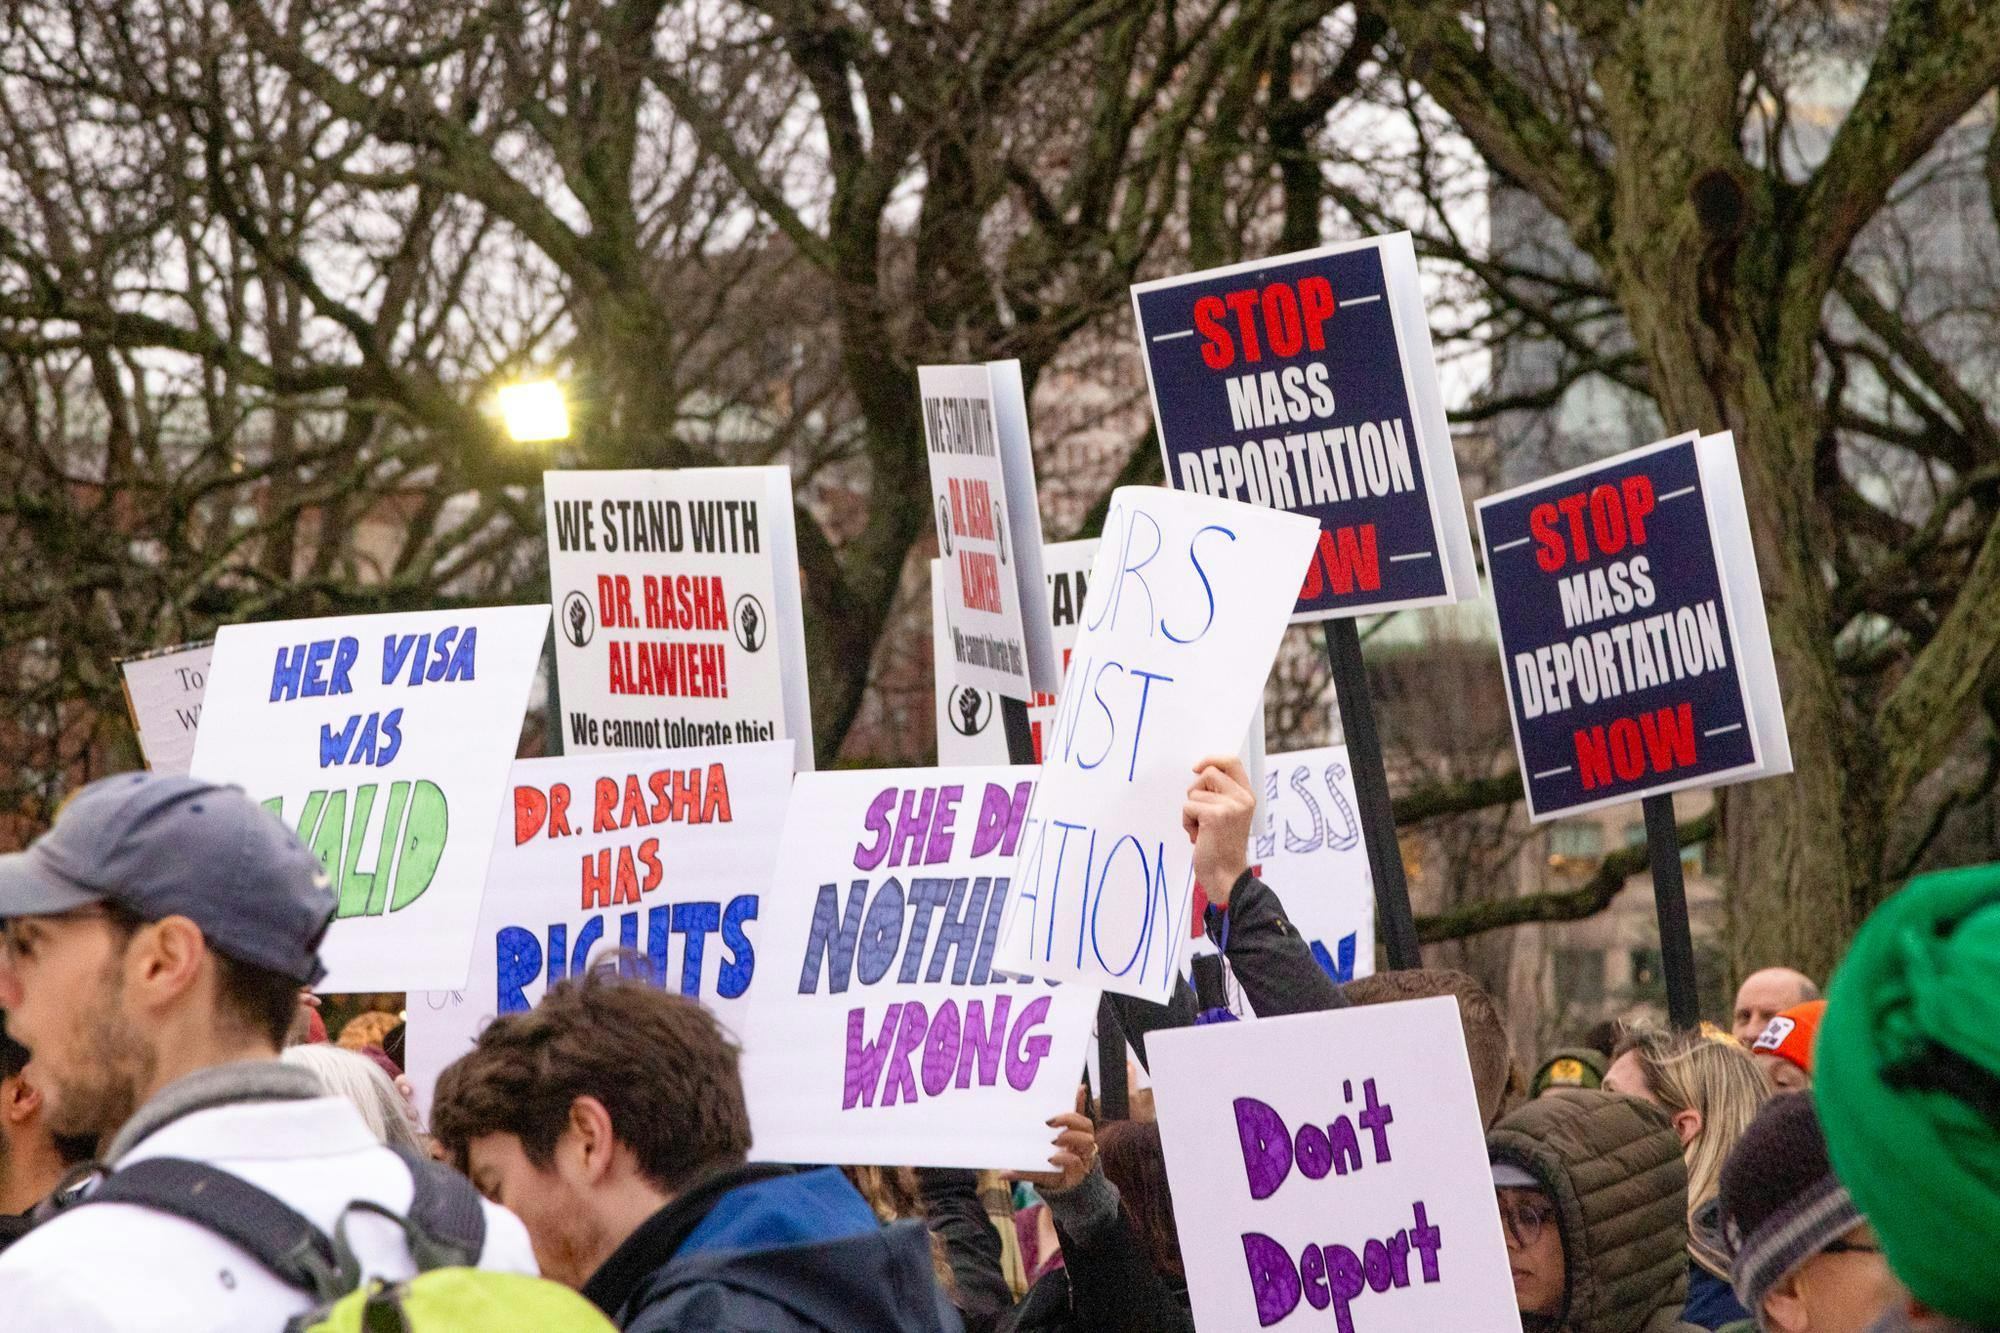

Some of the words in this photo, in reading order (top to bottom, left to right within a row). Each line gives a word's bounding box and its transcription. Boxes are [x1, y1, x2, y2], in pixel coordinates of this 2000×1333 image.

[1194, 276, 1335, 370] STOP
[1225, 361, 1336, 432] MASS
[1178, 418, 1415, 510] DEPORTATION
[554, 500, 596, 552] WE
[601, 499, 683, 553] STAND
[688, 500, 760, 554] WITH
[1529, 475, 1655, 572] STOP
[597, 574, 640, 628] DR.
[643, 574, 729, 631] RASHA
[1558, 555, 1656, 628] MASS
[269, 636, 359, 703] HER
[382, 626, 477, 687] VISA
[608, 641, 728, 699] ALAWIEH!
[1515, 600, 1727, 720] DEPORTATION
[320, 708, 403, 768] WAS
[570, 712, 598, 746] We
[602, 718, 661, 749] cannot
[1574, 703, 1697, 790] NOW
[514, 785, 582, 847] DR.
[593, 762, 733, 834] RASHA
[853, 785, 964, 872] SHE
[970, 781, 1038, 858] DI
[581, 838, 664, 911] HAS
[1003, 819, 1194, 991] ATION
[797, 876, 1063, 995] NOTHI
[842, 994, 1053, 1112] WRONG
[1232, 1077, 1394, 1200] Don't
[1241, 1200, 1442, 1333] Deport
